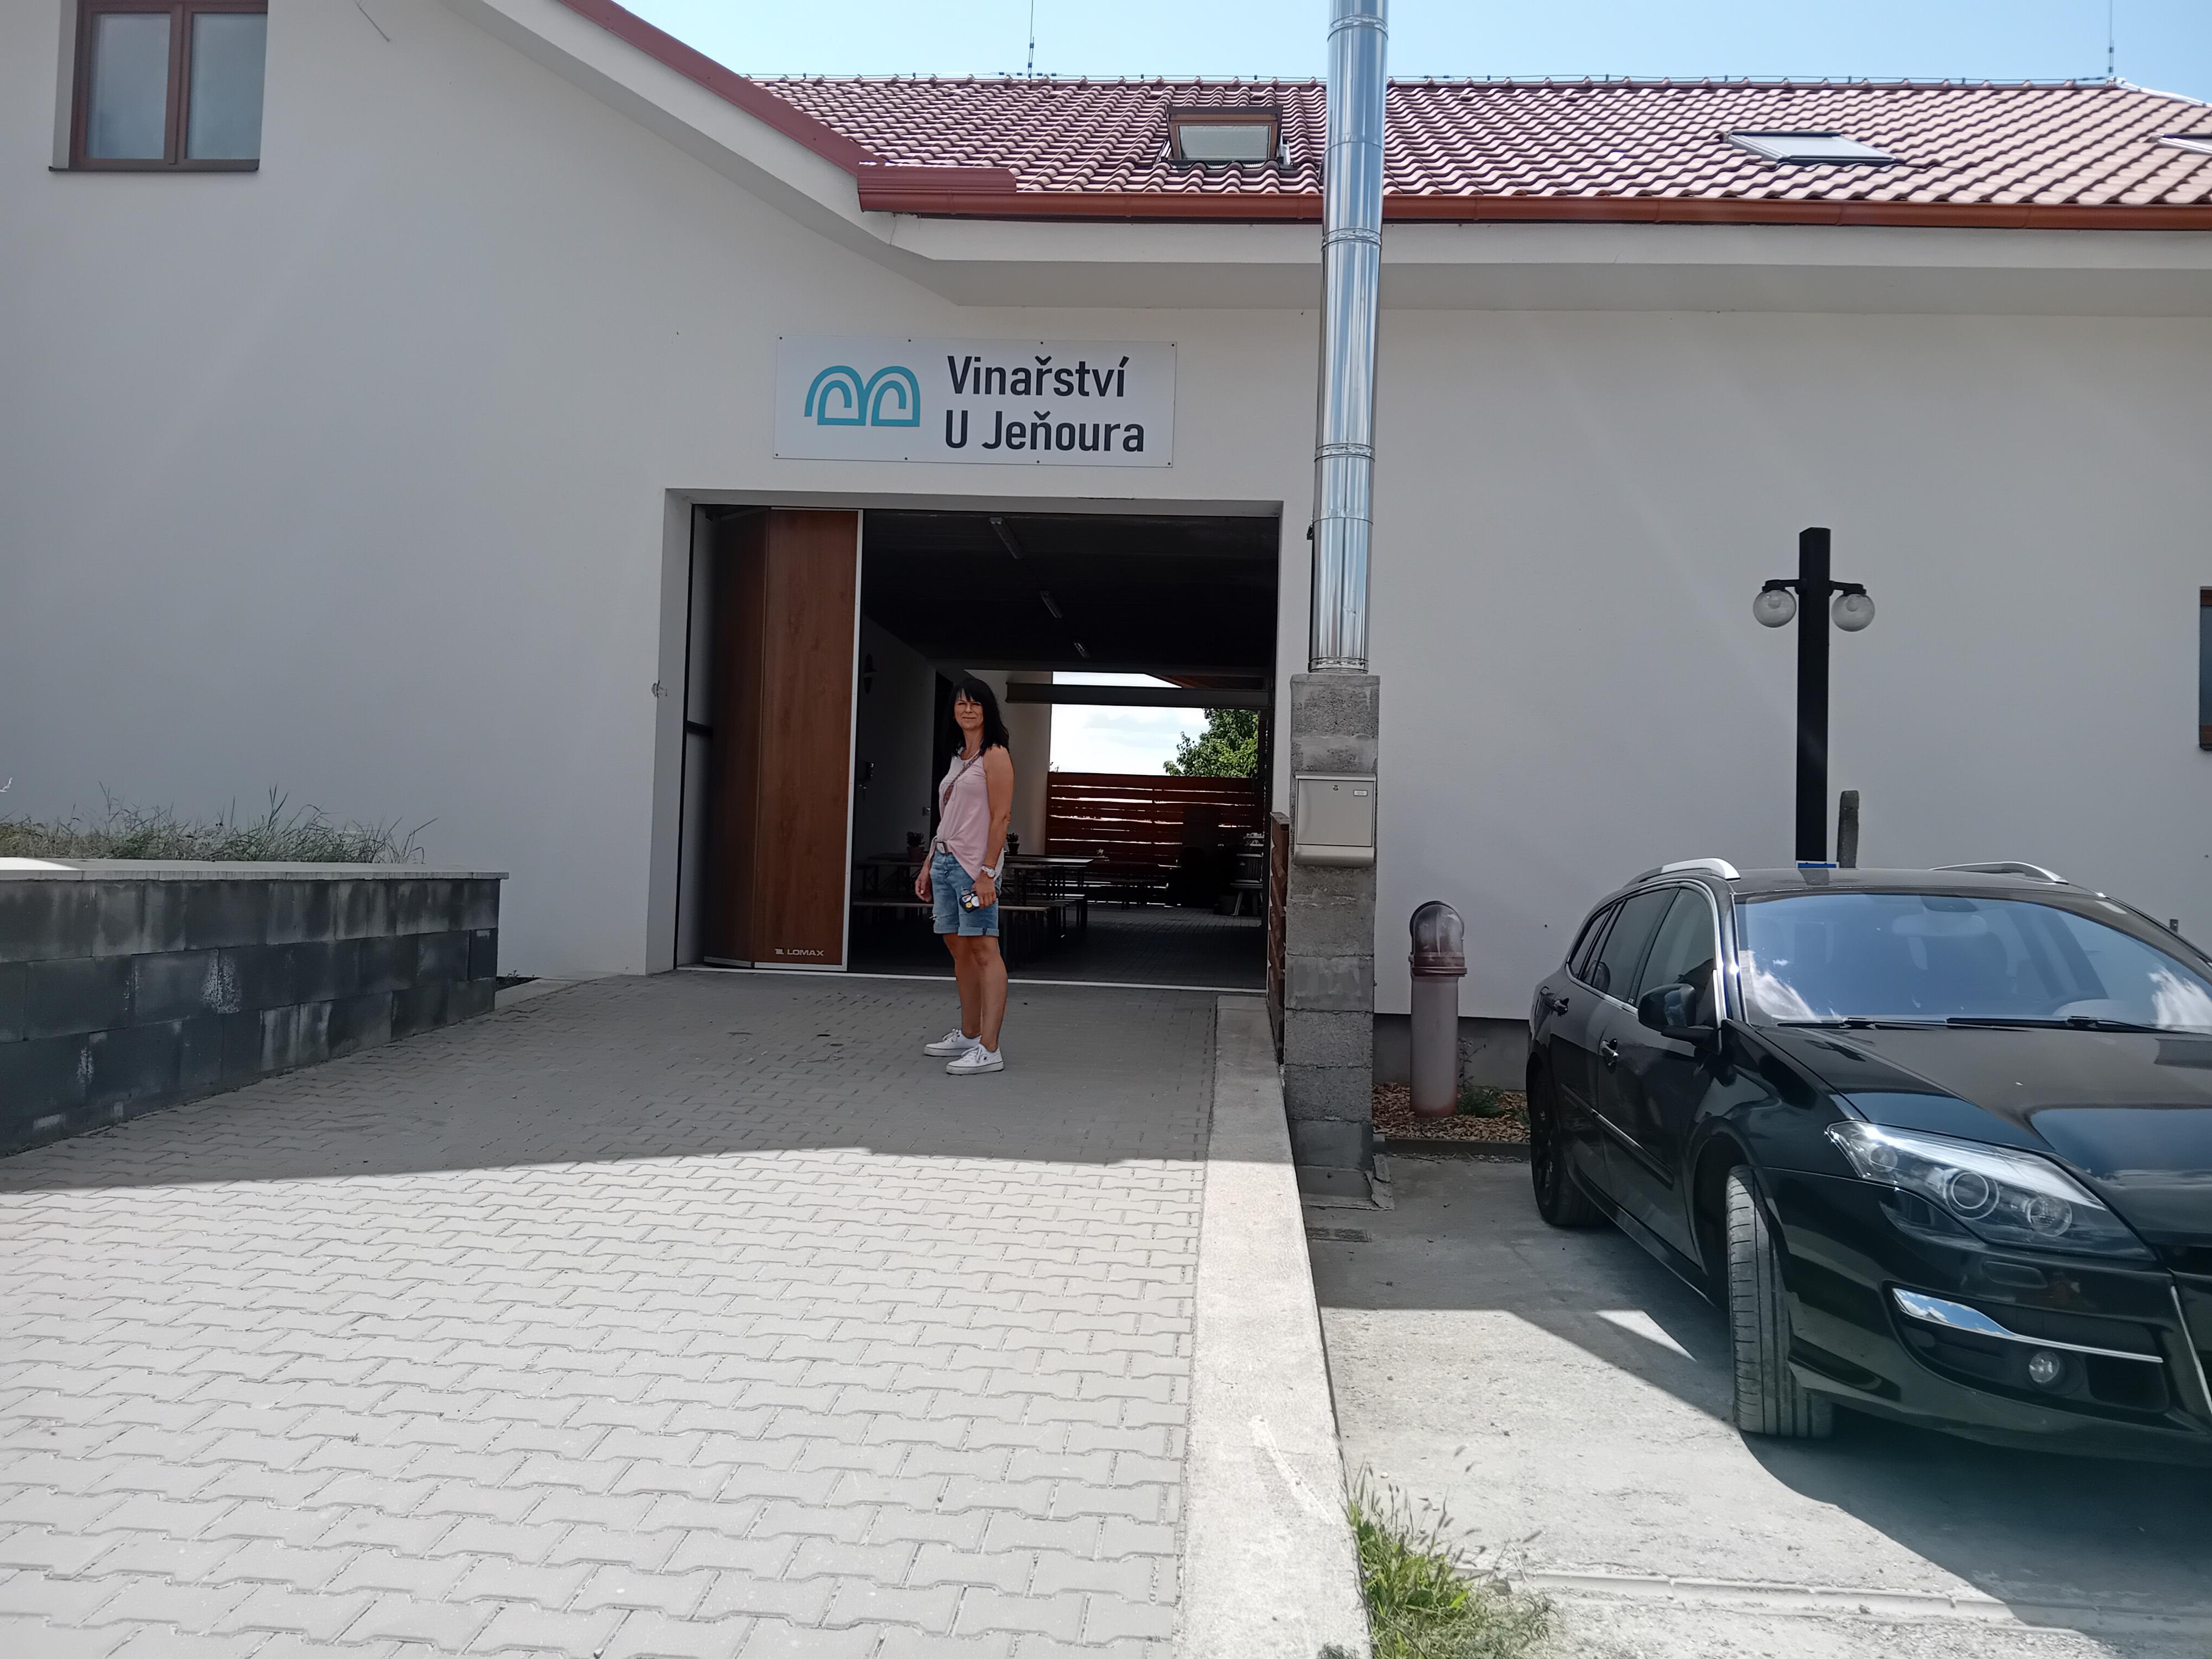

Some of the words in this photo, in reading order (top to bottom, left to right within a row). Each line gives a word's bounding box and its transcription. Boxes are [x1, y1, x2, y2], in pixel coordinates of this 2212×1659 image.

[947, 355, 1130, 397] Vinařství
[945, 410, 968, 448] U
[981, 410, 1145, 452] Jeňoura
